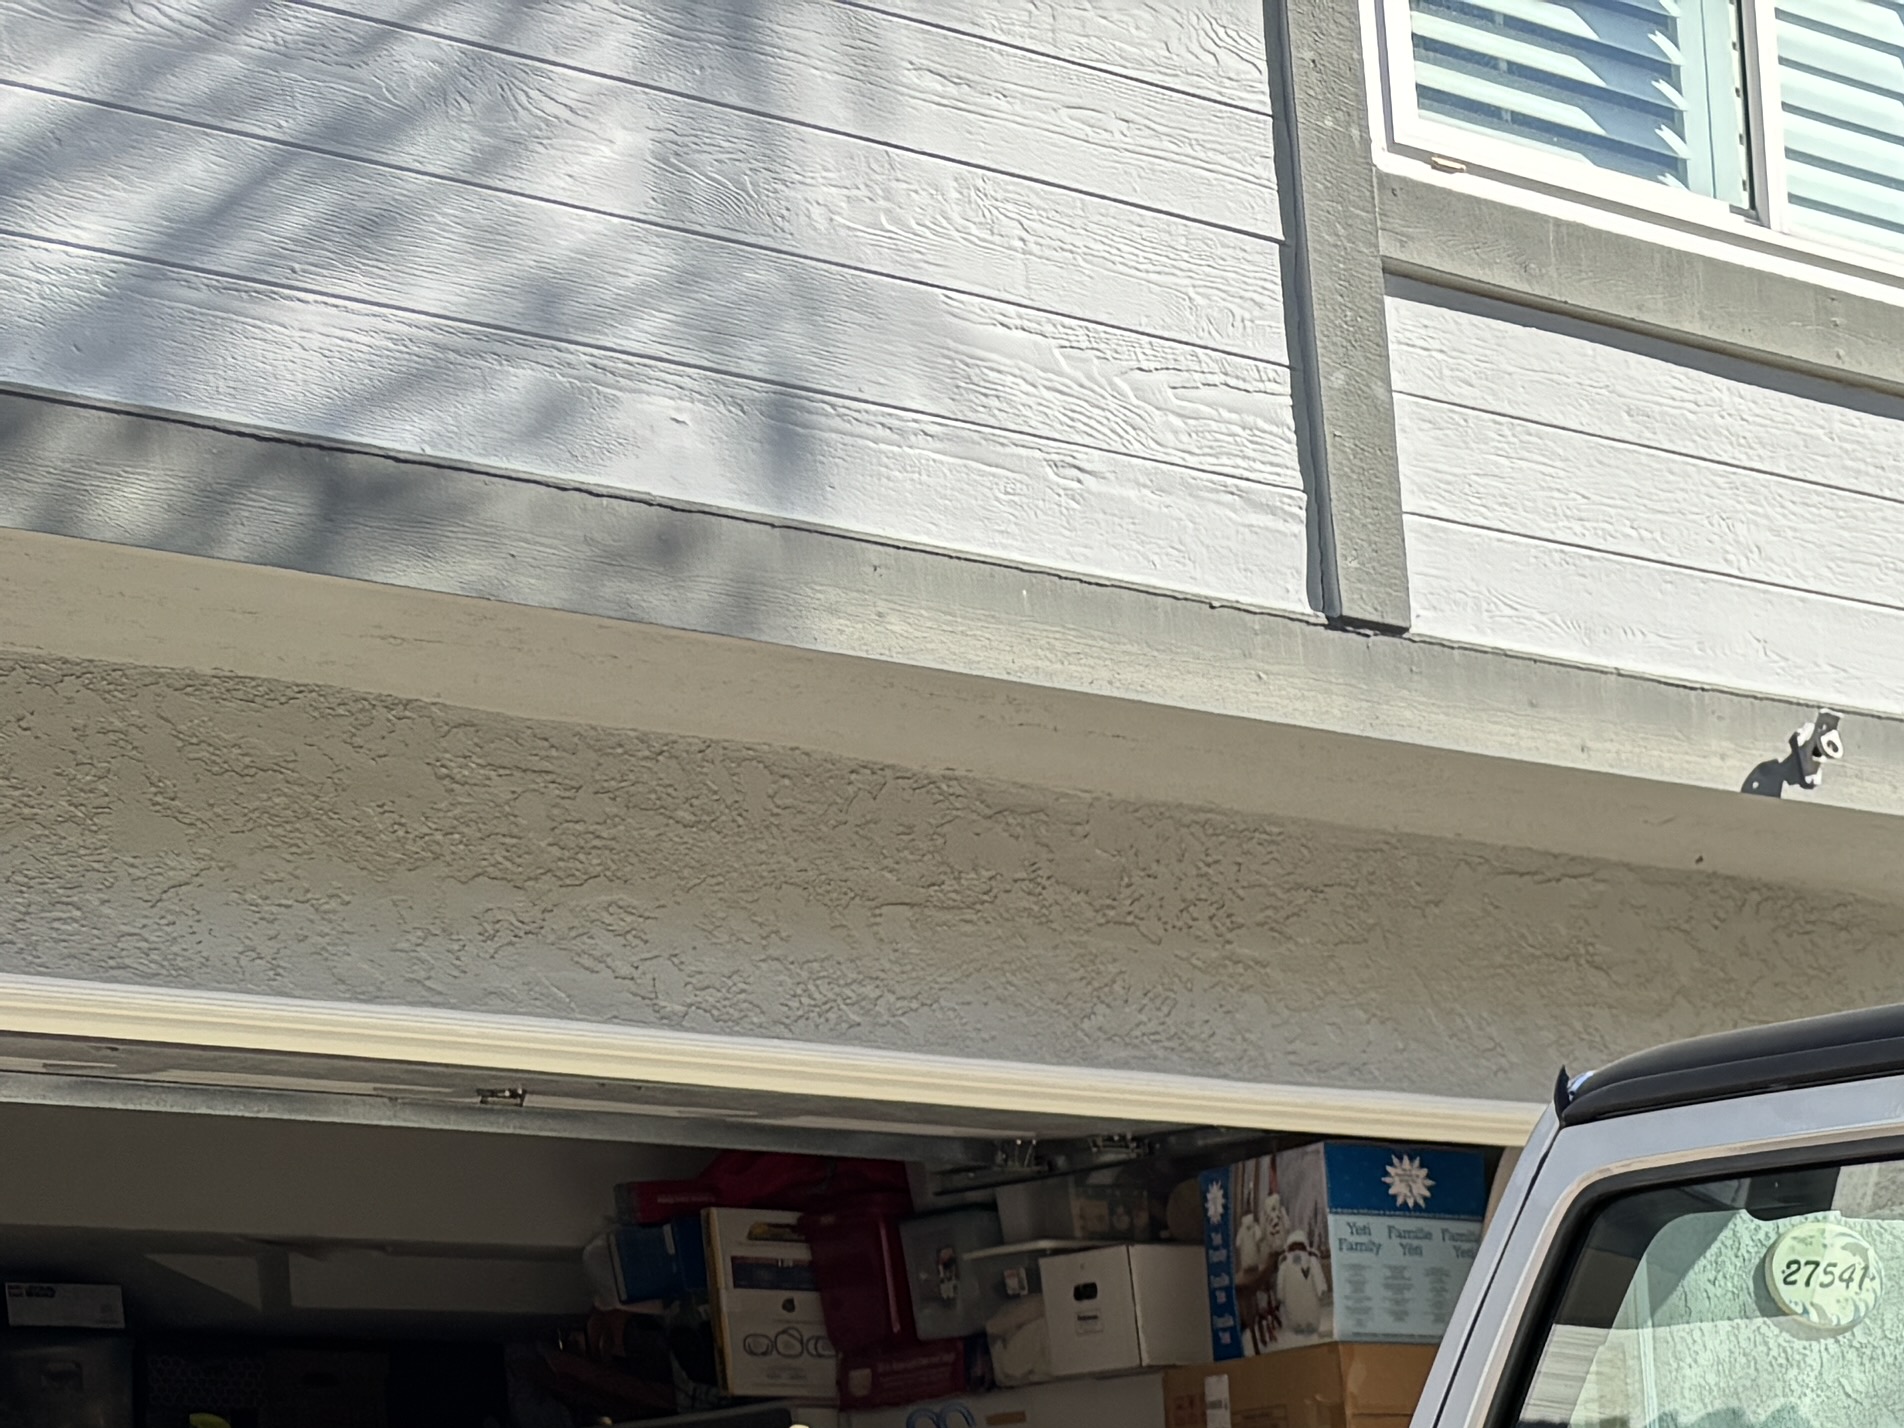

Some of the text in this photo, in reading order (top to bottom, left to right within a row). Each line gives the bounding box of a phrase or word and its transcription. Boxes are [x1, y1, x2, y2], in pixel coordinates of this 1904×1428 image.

[1345, 1221, 1372, 1237] Yeti
[1337, 1237, 1382, 1256] Family
[1782, 1259, 1869, 1292] 27541
